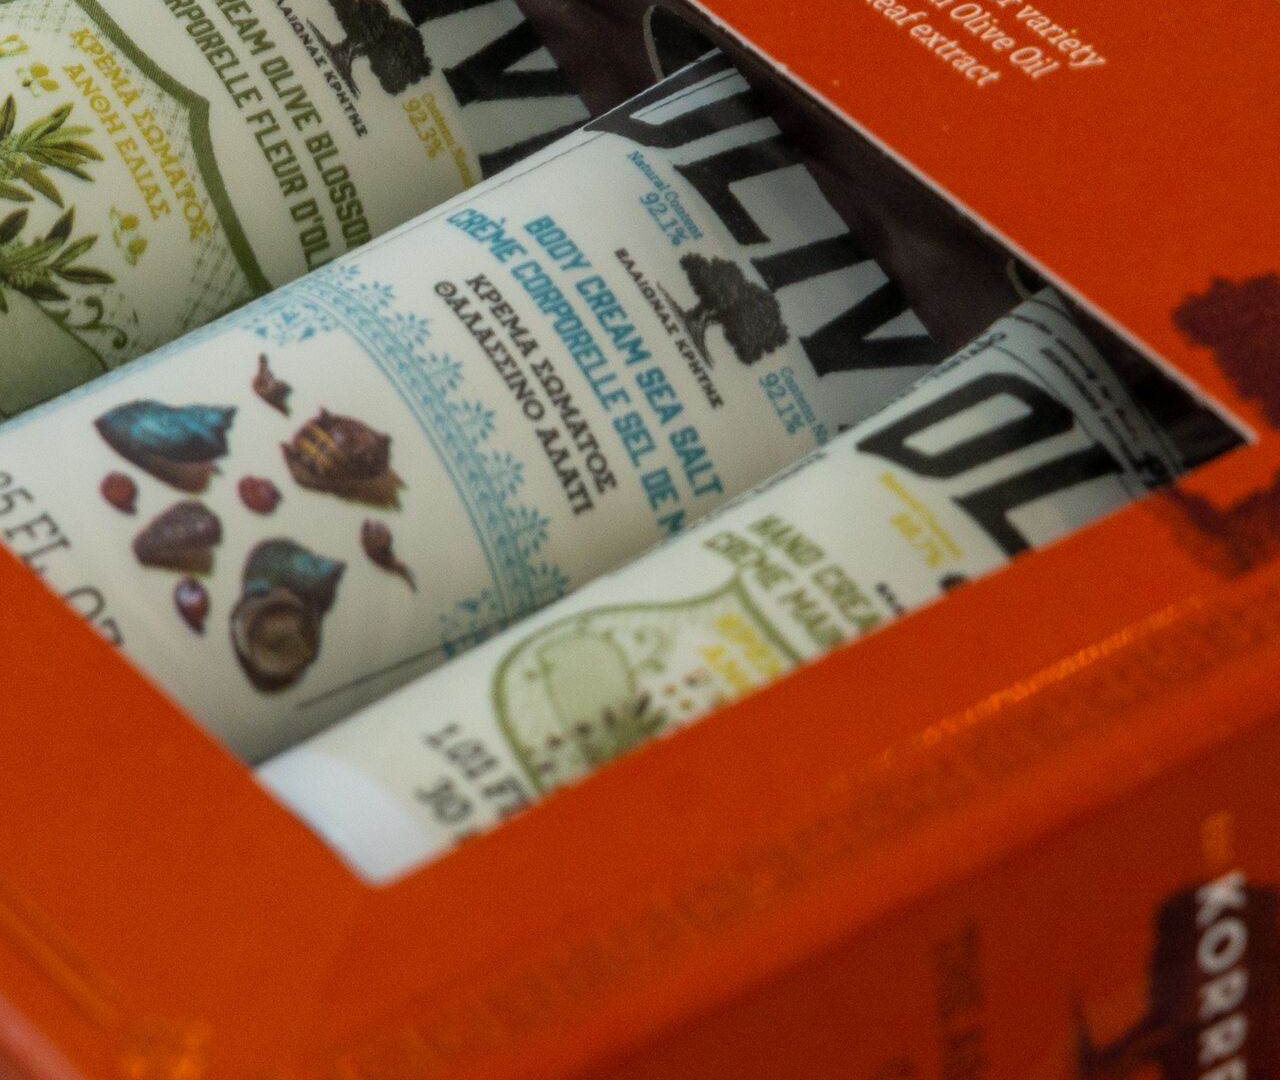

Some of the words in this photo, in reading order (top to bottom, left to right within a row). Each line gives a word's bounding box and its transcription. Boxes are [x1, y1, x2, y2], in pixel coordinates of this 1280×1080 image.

[909, 21, 1002, 88] extract
[949, 2, 1017, 51] Olive
[1009, 46, 1062, 81] Oil
[1015, 3, 1107, 71] variety
[63, 61, 125, 137] ΑΝΘΗ
[115, 138, 172, 221] ΕΛΙΑΣ
[69, 27, 142, 109] ΚΡΕΜΑ
[131, 106, 213, 242] ΣΩΜΑΤΟΣ
[323, 69, 368, 139] ΚΡΗΤΗΣ
[402, 97, 442, 160] 92.3%
[246, 101, 309, 199] FLEUR
[261, 54, 323, 133] OLIVE
[304, 129, 373, 249] BLOSSO
[626, 149, 672, 194] Natural
[640, 191, 690, 247] 92.1%
[446, 208, 528, 264] CRÈME
[510, 259, 632, 413] CORPORELLE
[612, 410, 656, 469] SEL
[640, 466, 681, 512] DE
[466, 273, 540, 360] ΚΡΕΜΑ
[530, 357, 620, 498] ΣΩΜΑΤΟΣ
[523, 215, 593, 272] BODY
[575, 273, 652, 367] CREAM
[634, 365, 684, 427] SEA
[669, 424, 724, 499] SALT
[675, 336, 724, 411] ΚΡΗΤΗΣ
[433, 280, 547, 423] ΘΑΛΑΣΣΙΝΟ
[535, 426, 597, 520] ΑΛΑΤΙ
[758, 372, 805, 436] 92.1%
[746, 512, 826, 570] HAND
